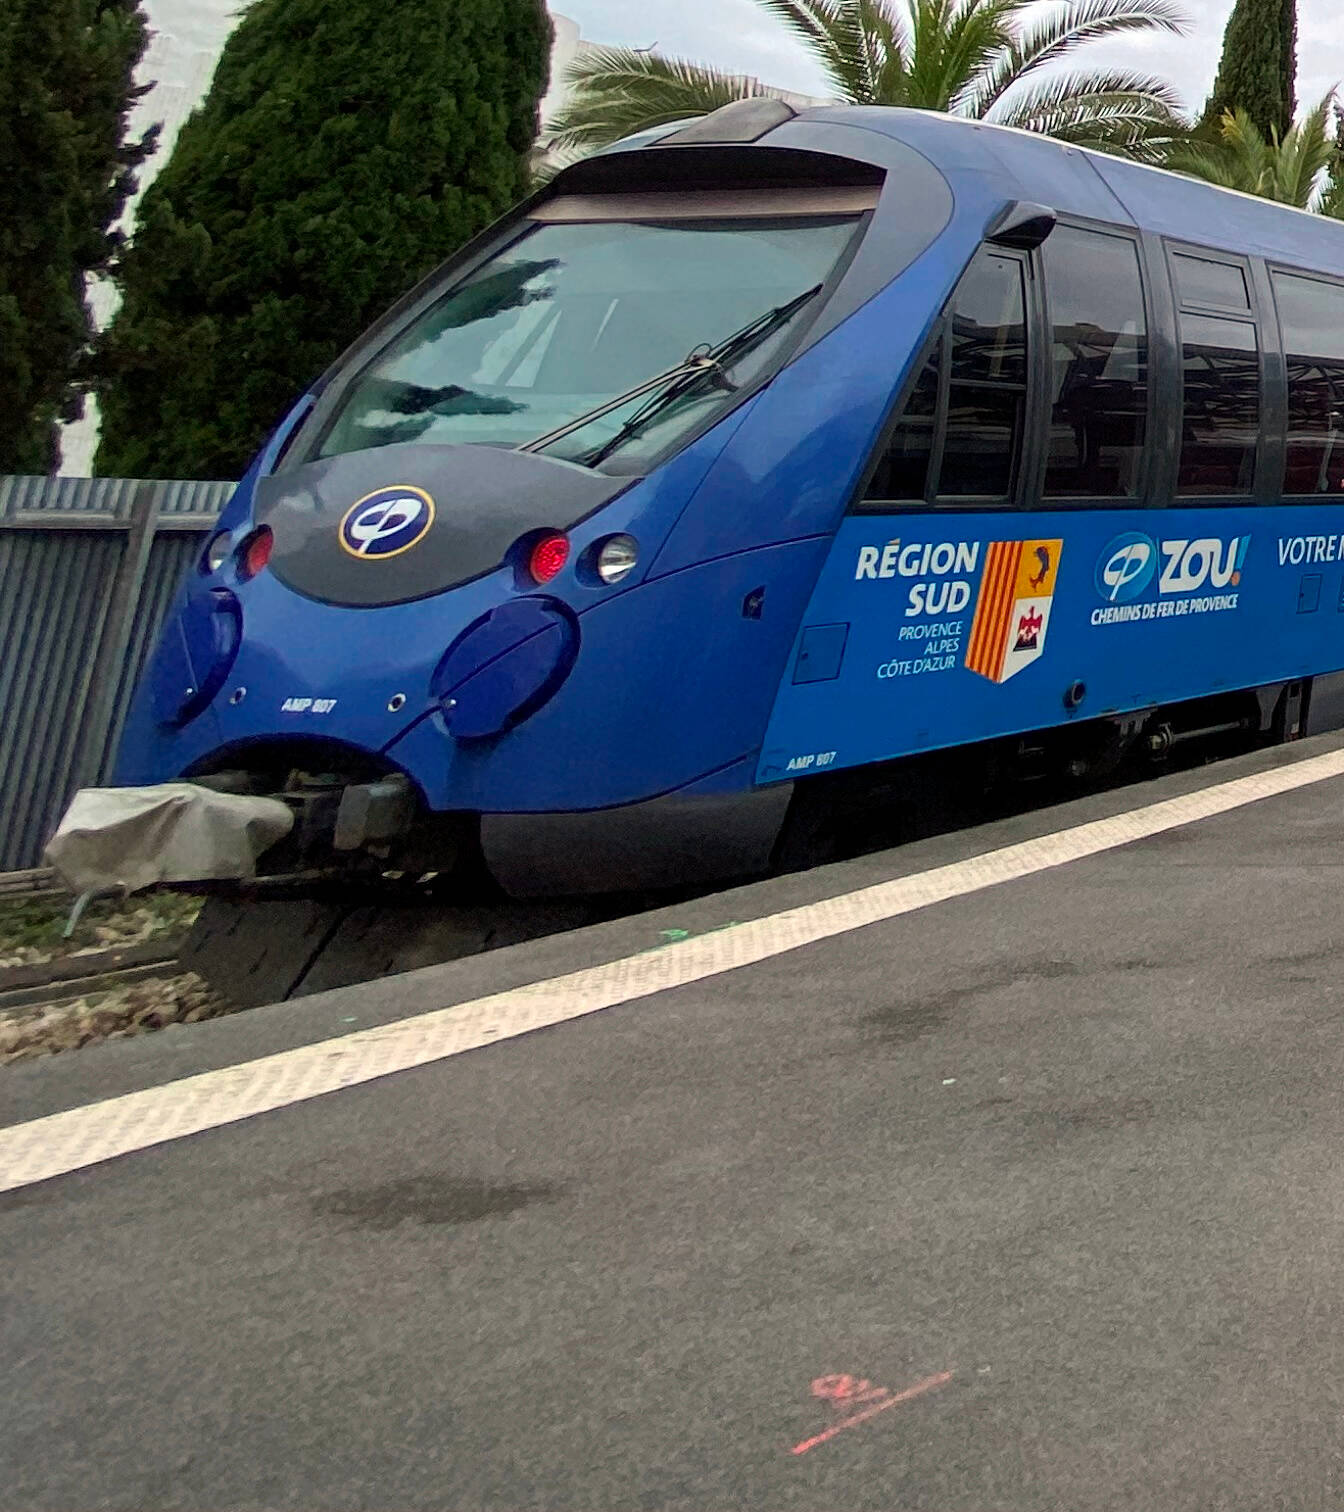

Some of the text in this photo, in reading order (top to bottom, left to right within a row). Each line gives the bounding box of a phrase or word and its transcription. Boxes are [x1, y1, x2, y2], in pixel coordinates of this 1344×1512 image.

[855, 538, 980, 580] RÉGION
[1159, 534, 1252, 594] ZOU!
[1278, 535, 1338, 565] VOTRE
[905, 580, 971, 617] SUD
[1091, 594, 1239, 625] CHEMINS DE FER DE PROVENCE
[898, 620, 963, 640] PROVENCE
[924, 637, 960, 655] ALPES
[877, 655, 956, 679] CÔTE D'AZUR
[786, 754, 815, 771] AMP
